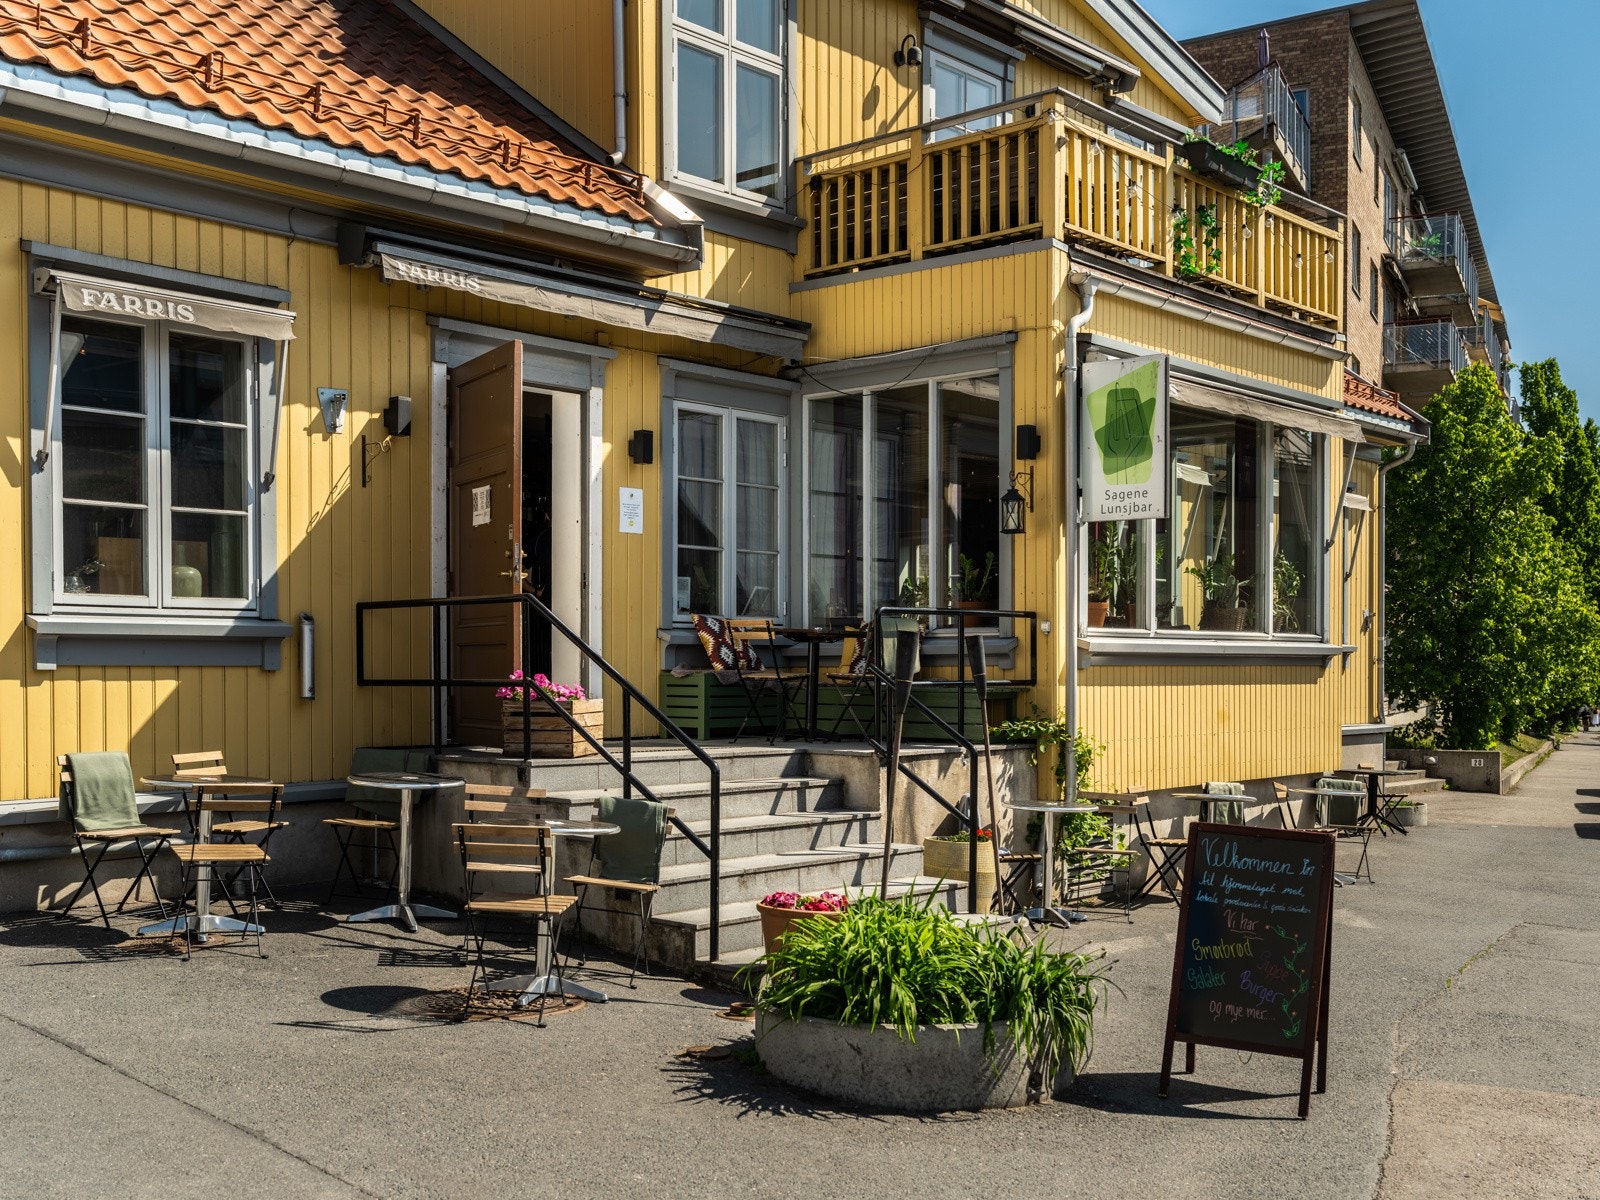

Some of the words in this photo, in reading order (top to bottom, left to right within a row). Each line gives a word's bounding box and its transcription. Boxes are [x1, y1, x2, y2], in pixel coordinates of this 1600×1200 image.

[398, 260, 482, 292] FARRIS
[81, 287, 196, 323] FARRIS
[1104, 489, 1149, 502] Sagene
[1100, 502, 1153, 516] Lunsjbar
[1201, 837, 1295, 875] Velkommen
[1239, 913, 1260, 931] har
[1187, 966, 1226, 990] Salater
[1240, 970, 1285, 1007] Burger
[1225, 1004, 1243, 1023] mye
